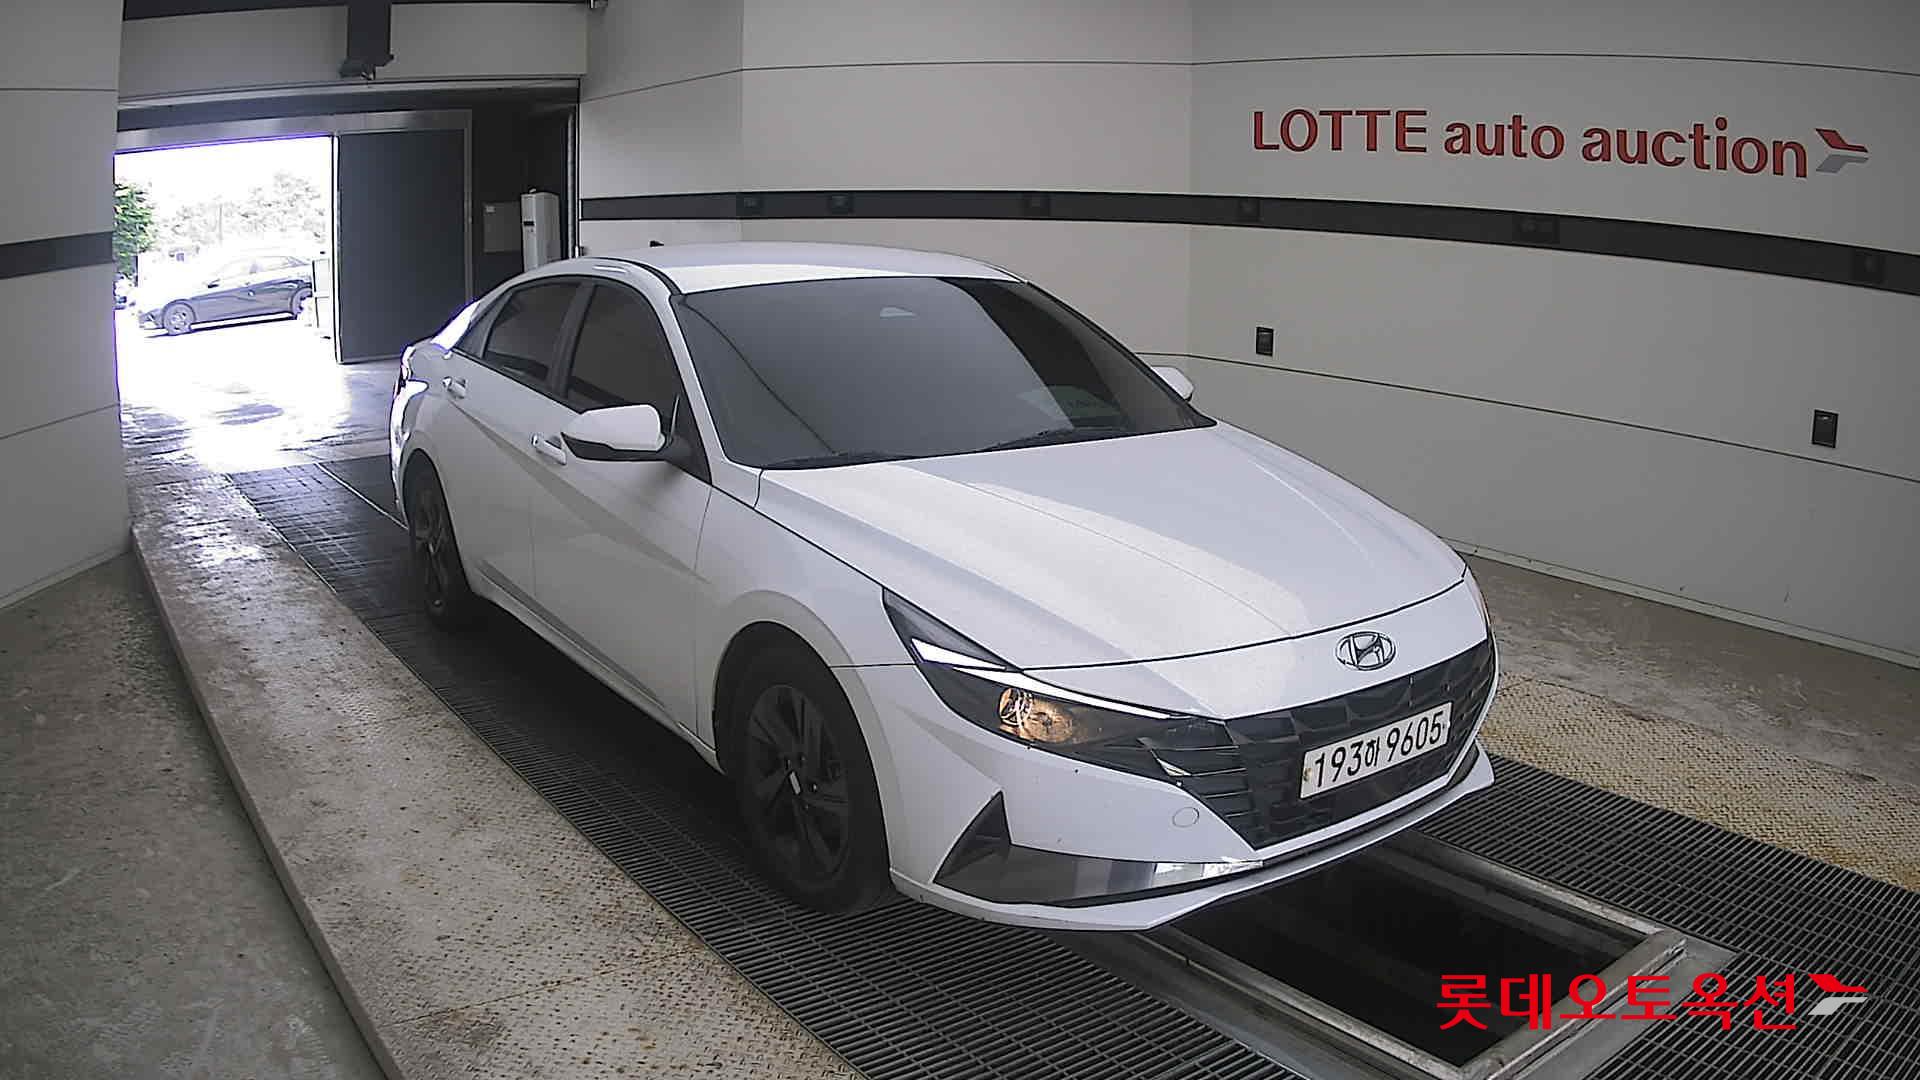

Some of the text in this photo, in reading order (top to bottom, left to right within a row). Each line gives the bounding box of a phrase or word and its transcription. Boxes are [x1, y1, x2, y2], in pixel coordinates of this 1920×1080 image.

[1253, 109, 1808, 178] LOTTE auto auction
[1314, 711, 1444, 788] 193하 9605
